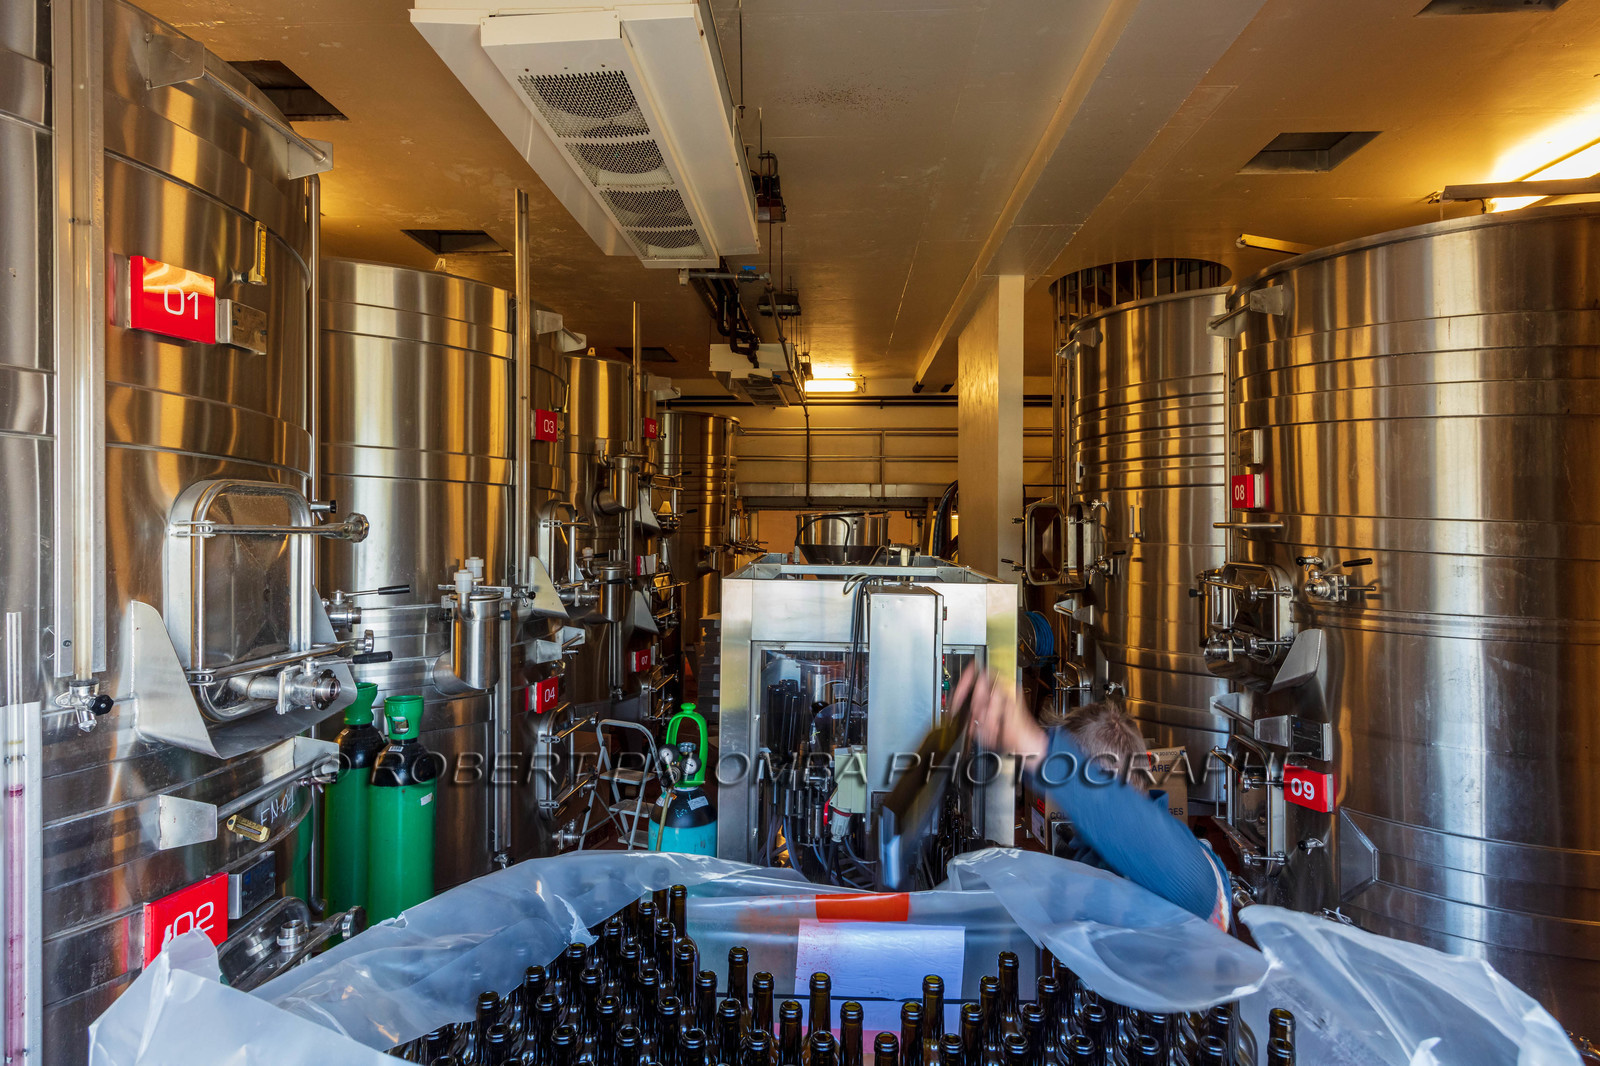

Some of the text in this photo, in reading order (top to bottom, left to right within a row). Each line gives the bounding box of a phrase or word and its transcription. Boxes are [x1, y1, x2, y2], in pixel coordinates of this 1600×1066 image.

[163, 284, 199, 320] 01
[543, 419, 555, 434] 03
[1234, 484, 1246, 501] 08
[641, 655, 649, 665] 07
[544, 686, 556, 703] 04
[1291, 777, 1315, 801] 09
[172, 901, 215, 938] 02
